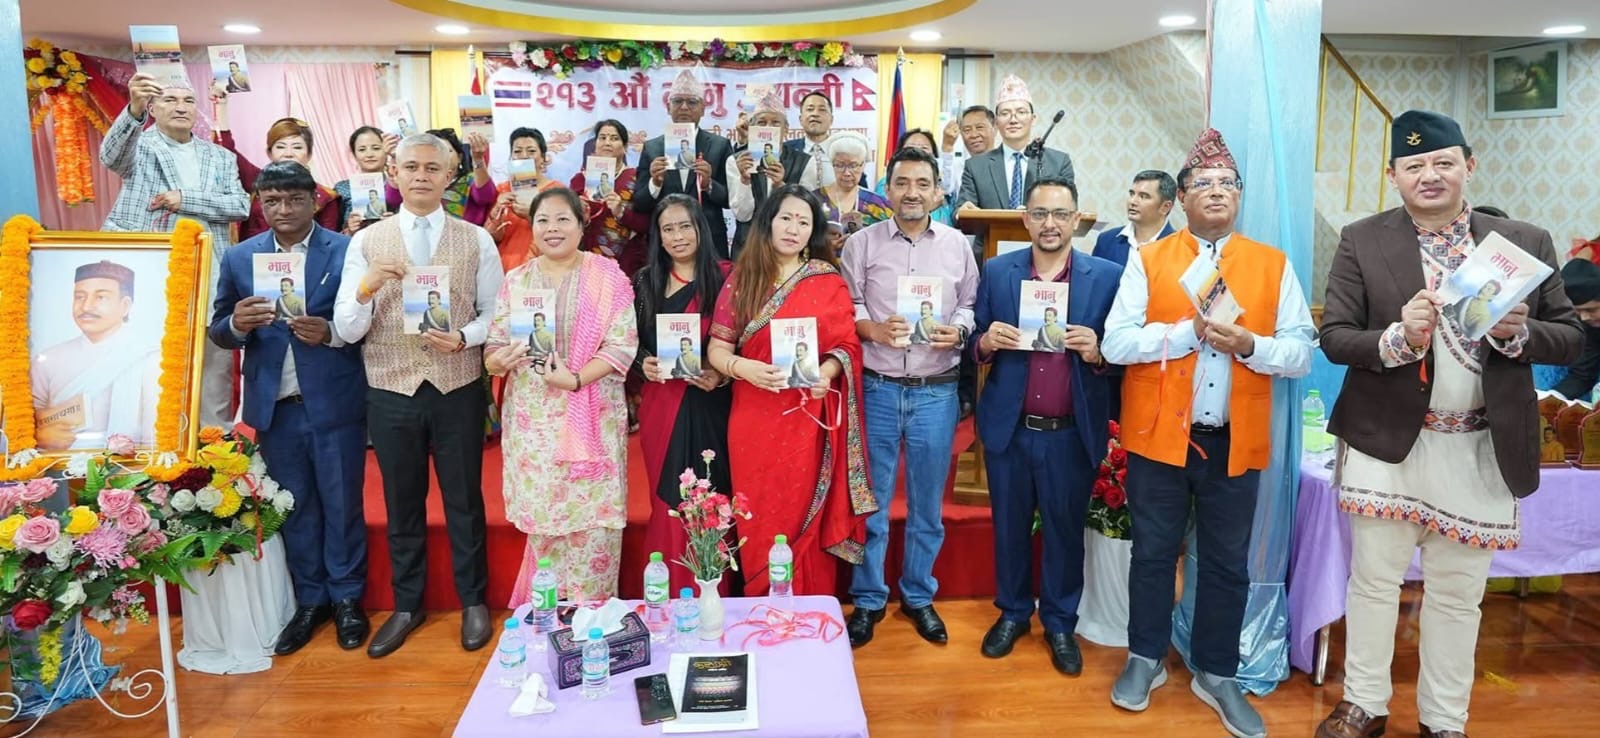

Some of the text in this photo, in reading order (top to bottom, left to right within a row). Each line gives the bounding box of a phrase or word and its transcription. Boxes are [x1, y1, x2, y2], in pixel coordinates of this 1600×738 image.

[536, 81, 597, 111] २१३
[268, 261, 291, 273] भानु
[1490, 250, 1519, 279] भानु
[416, 274, 438, 287] भानु
[911, 283, 932, 297] भानु
[1034, 289, 1057, 303] भानु
[523, 296, 544, 310] भानु
[669, 321, 691, 334] भानु
